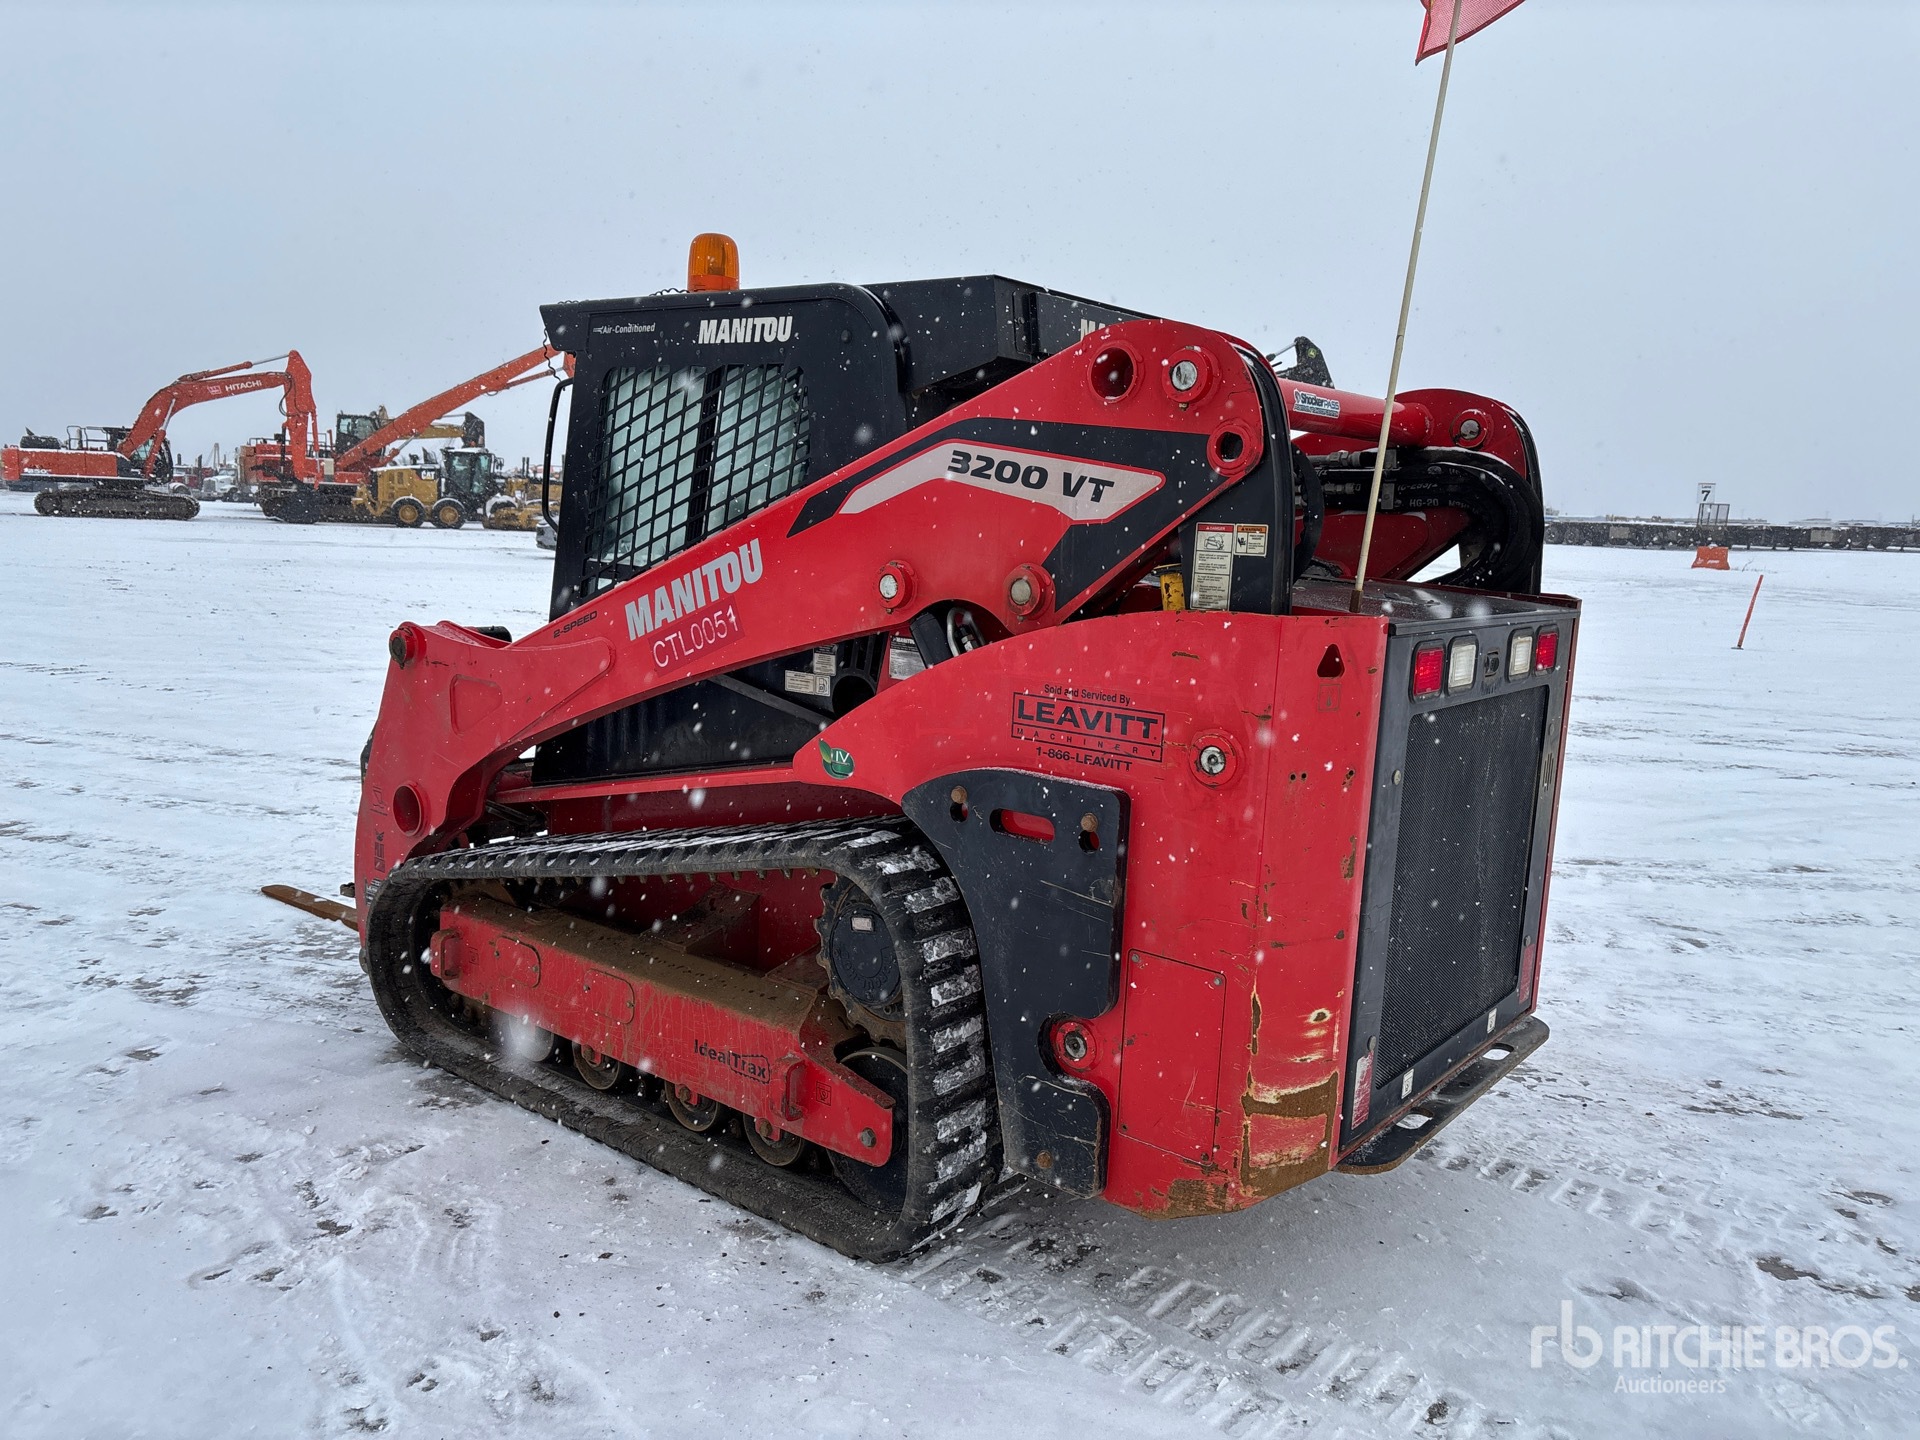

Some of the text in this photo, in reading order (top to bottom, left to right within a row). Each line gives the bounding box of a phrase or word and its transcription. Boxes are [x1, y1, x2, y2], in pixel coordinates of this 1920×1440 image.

[602, 322, 655, 334] Air-Conditioned
[698, 316, 793, 344] MANITOU
[225, 380, 262, 391] HITACHI
[421, 470, 436, 480] CAT
[947, 450, 1115, 503] 3200 VT
[1409, 498, 1439, 507] HG-20
[1701, 489, 1711, 501] 7
[624, 537, 764, 641] MANITOU
[553, 610, 598, 639] 2-SPEED
[653, 604, 739, 668] CTL0051
[1044, 684, 1131, 706] Sold and Serviced By
[1017, 699, 1158, 739] LEAVITT
[1035, 746, 1133, 772] 1-866-LEAVITT
[694, 1039, 767, 1079] IdealTrax
